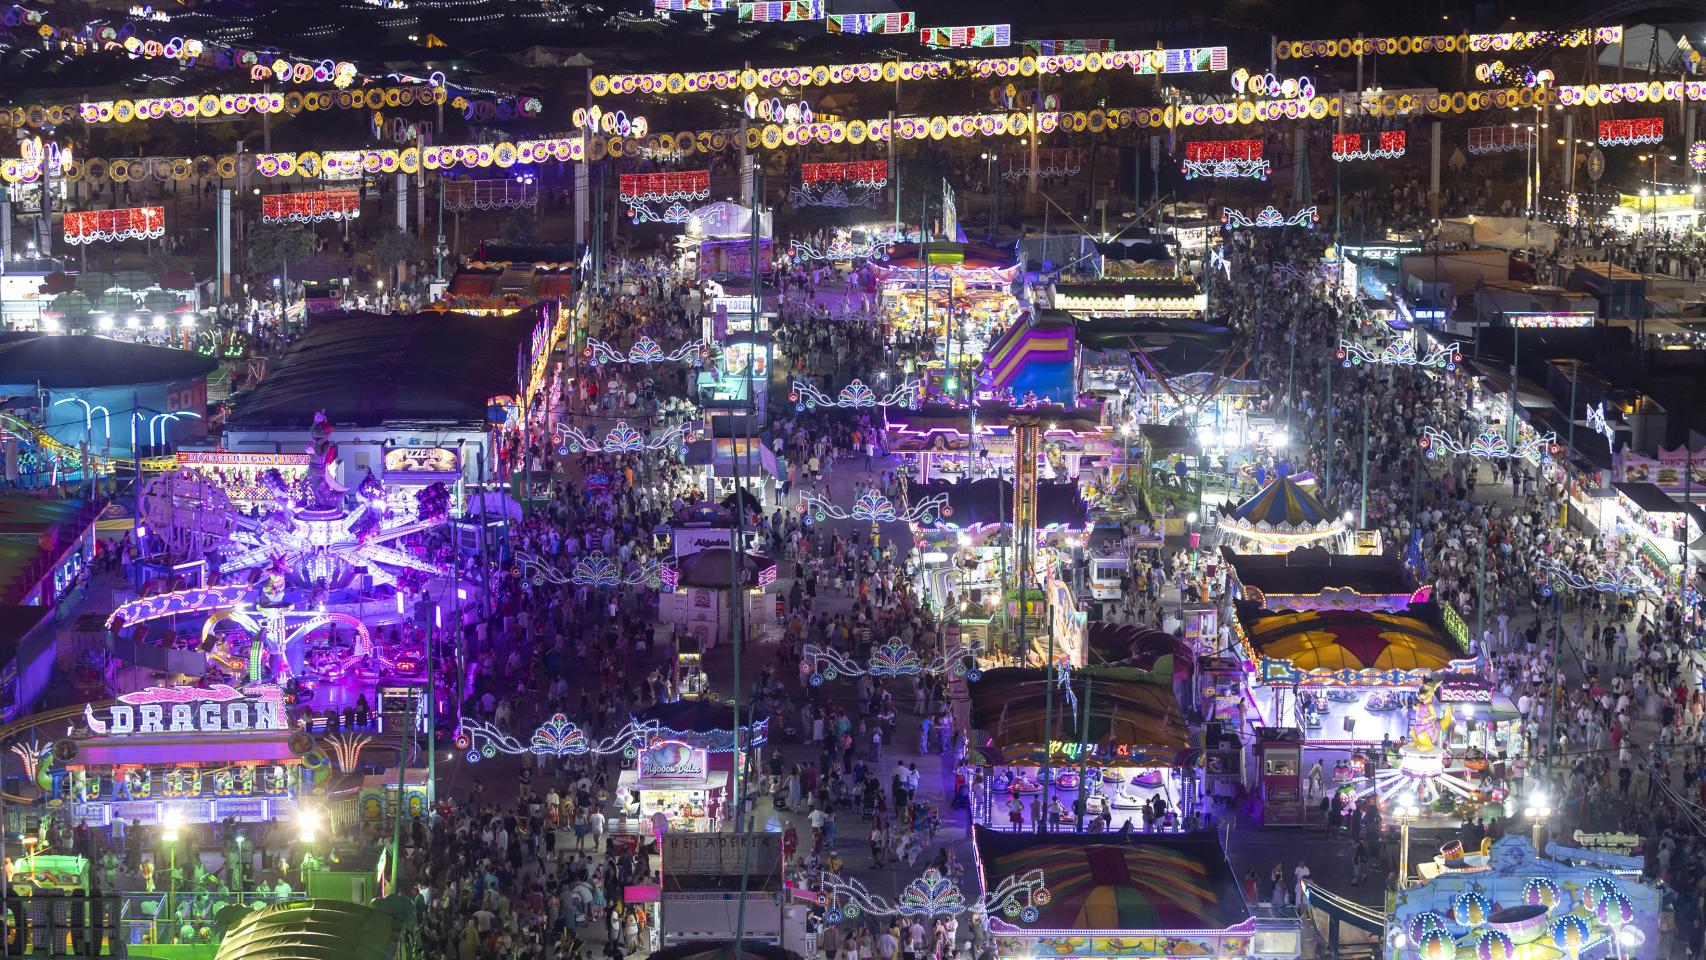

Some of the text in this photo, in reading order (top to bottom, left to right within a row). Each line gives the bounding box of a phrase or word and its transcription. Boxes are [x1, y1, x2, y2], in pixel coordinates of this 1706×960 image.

[110, 702, 280, 733] DRAGON
[644, 764, 701, 775] Algodón Dulce
[671, 838, 769, 849] HELADERIA
